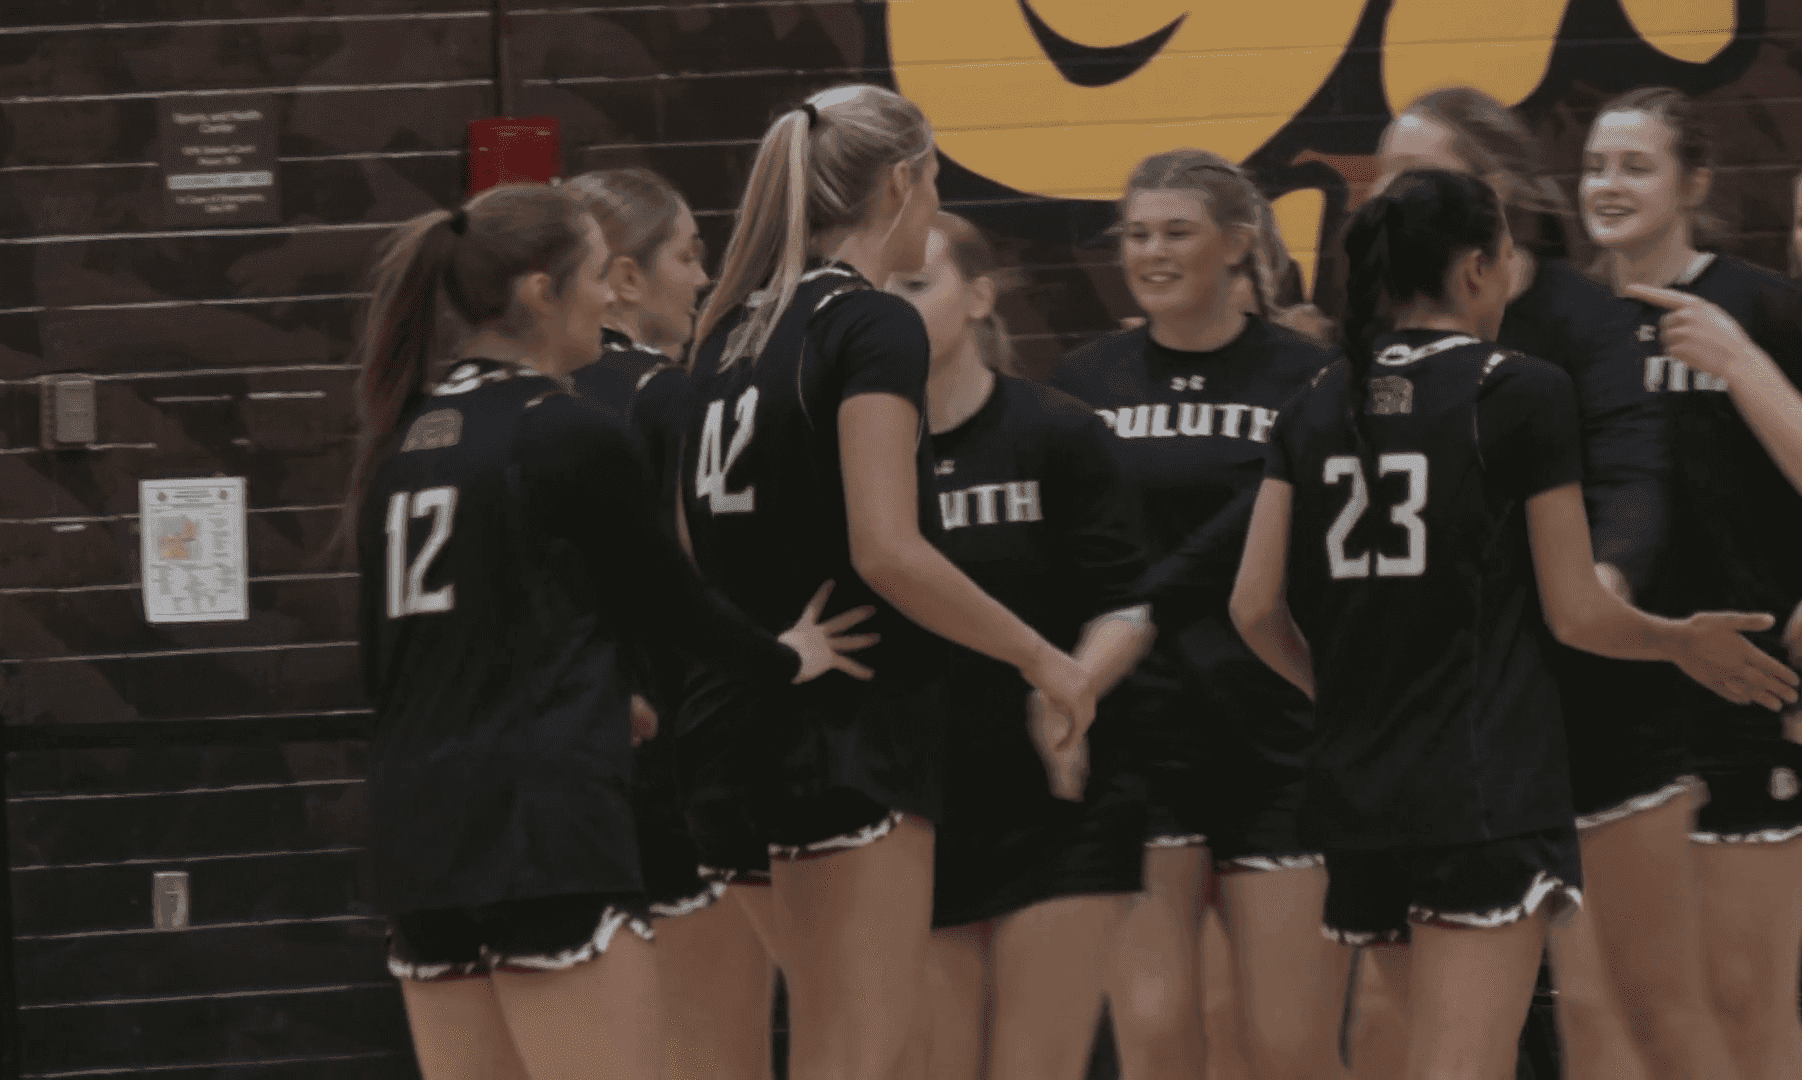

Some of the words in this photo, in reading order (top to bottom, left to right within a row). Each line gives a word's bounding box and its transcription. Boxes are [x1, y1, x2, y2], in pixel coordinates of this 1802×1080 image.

[695, 386, 758, 516] 42
[1323, 452, 1429, 578] 23
[386, 485, 459, 619] 12
